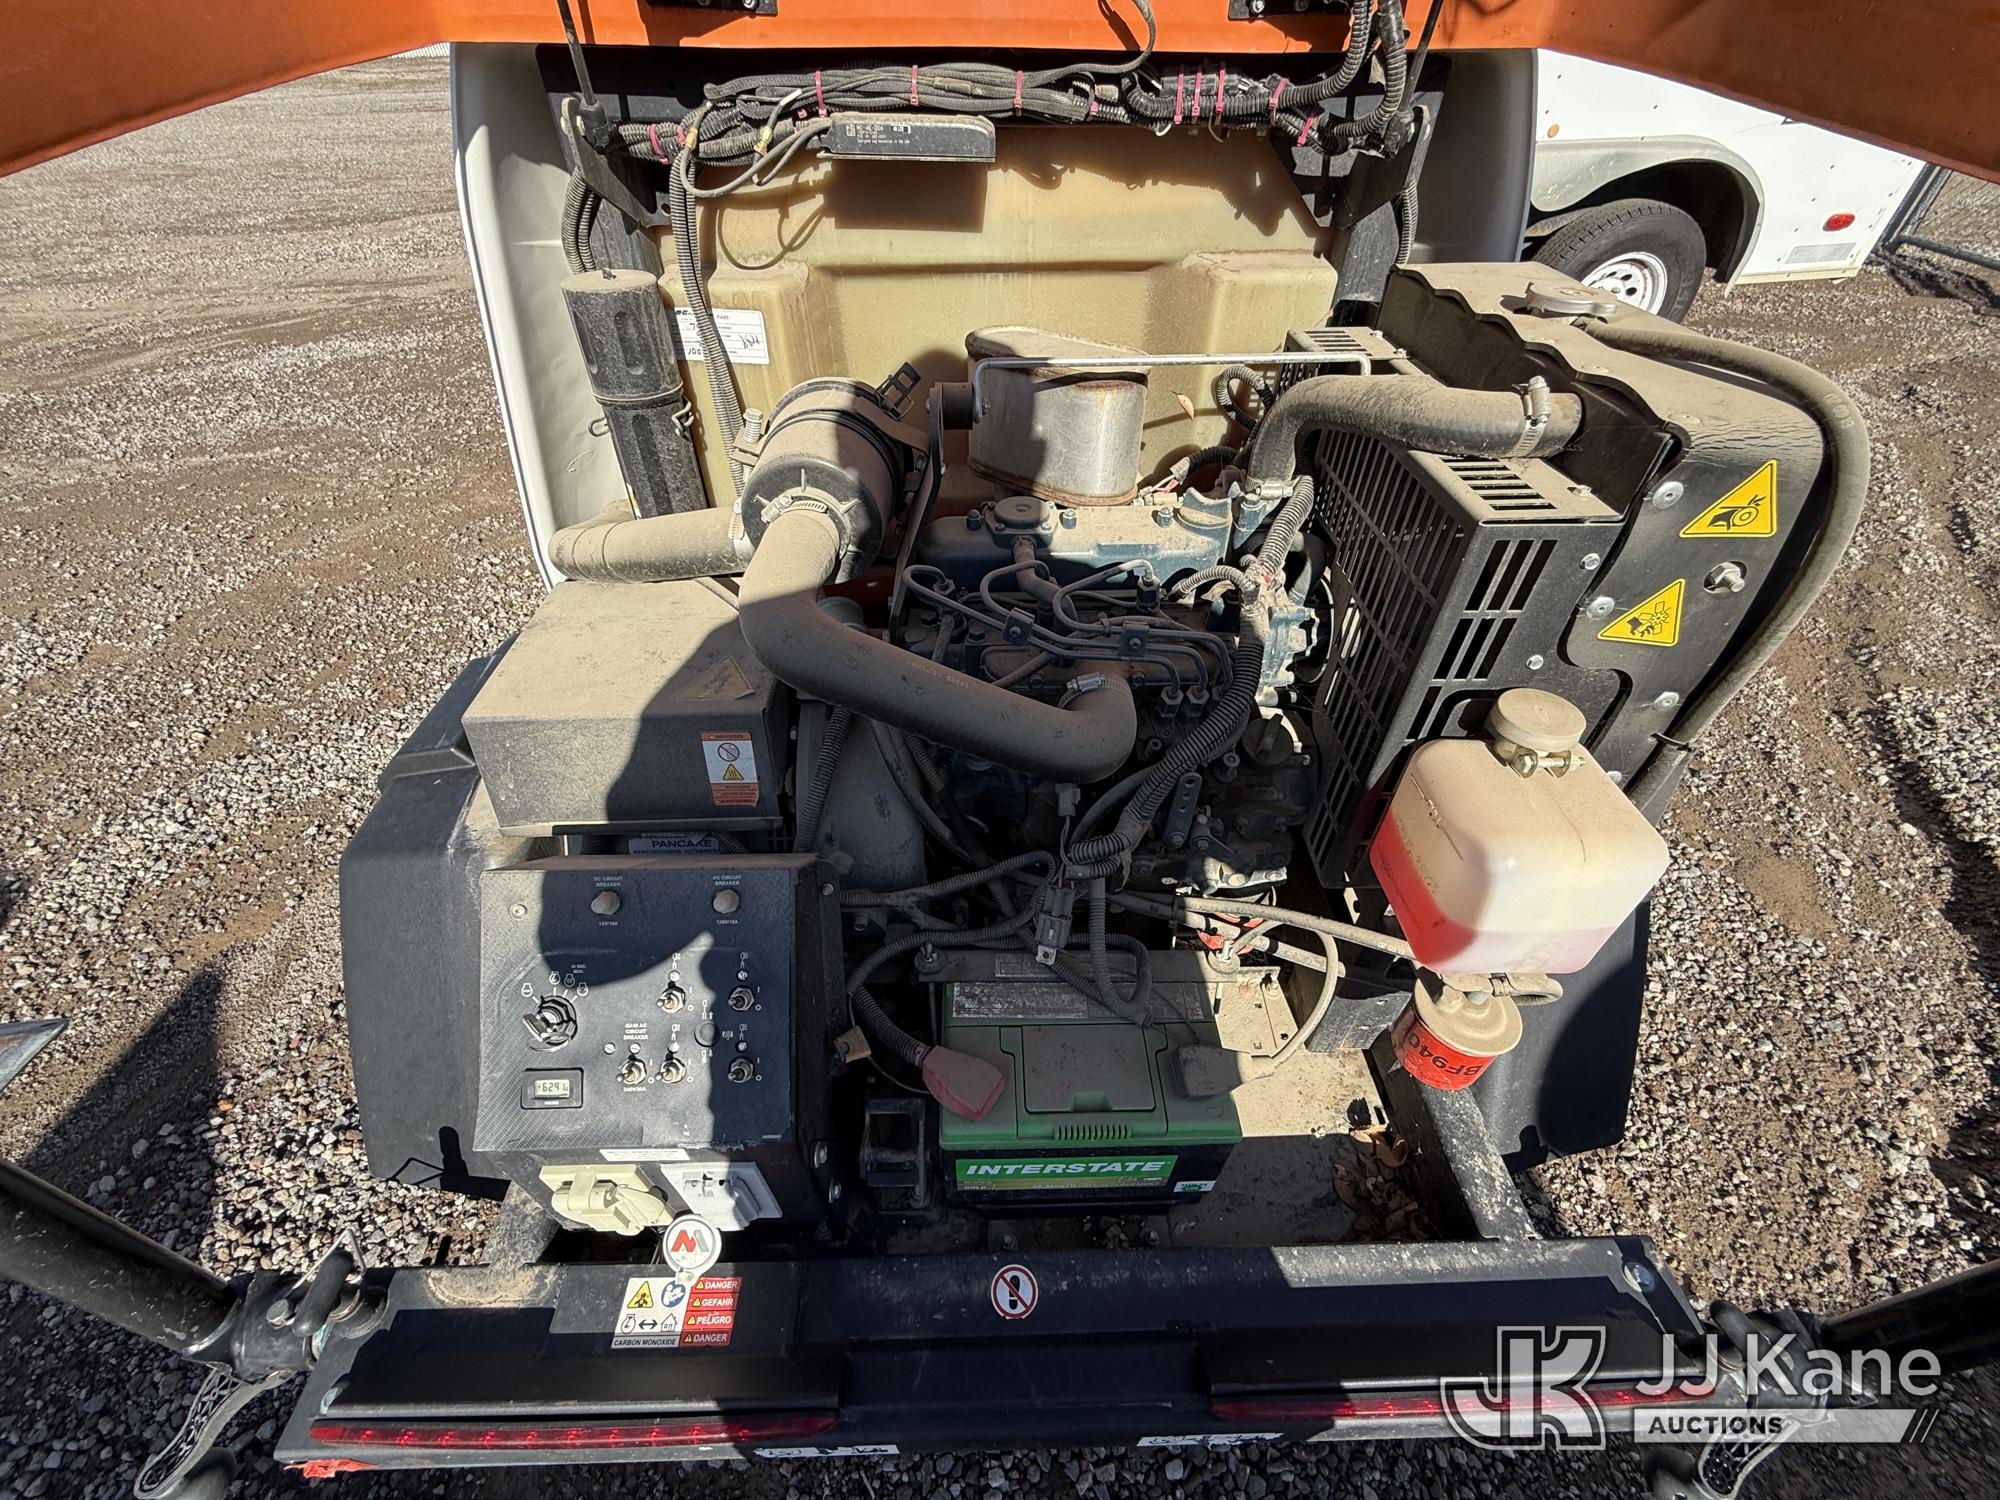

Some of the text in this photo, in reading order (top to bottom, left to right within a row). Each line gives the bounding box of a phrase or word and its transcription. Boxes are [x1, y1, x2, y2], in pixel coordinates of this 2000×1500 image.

[651, 839, 712, 848] PANCAKE
[966, 1161, 1165, 1176] INTERSTATE
[704, 1281, 738, 1289] DANGER
[701, 1297, 734, 1307] GEFAHR
[696, 1315, 732, 1325] PELIGRO
[613, 1338, 677, 1347] CARBON MONOXIDE
[693, 1334, 728, 1342] DANGER
